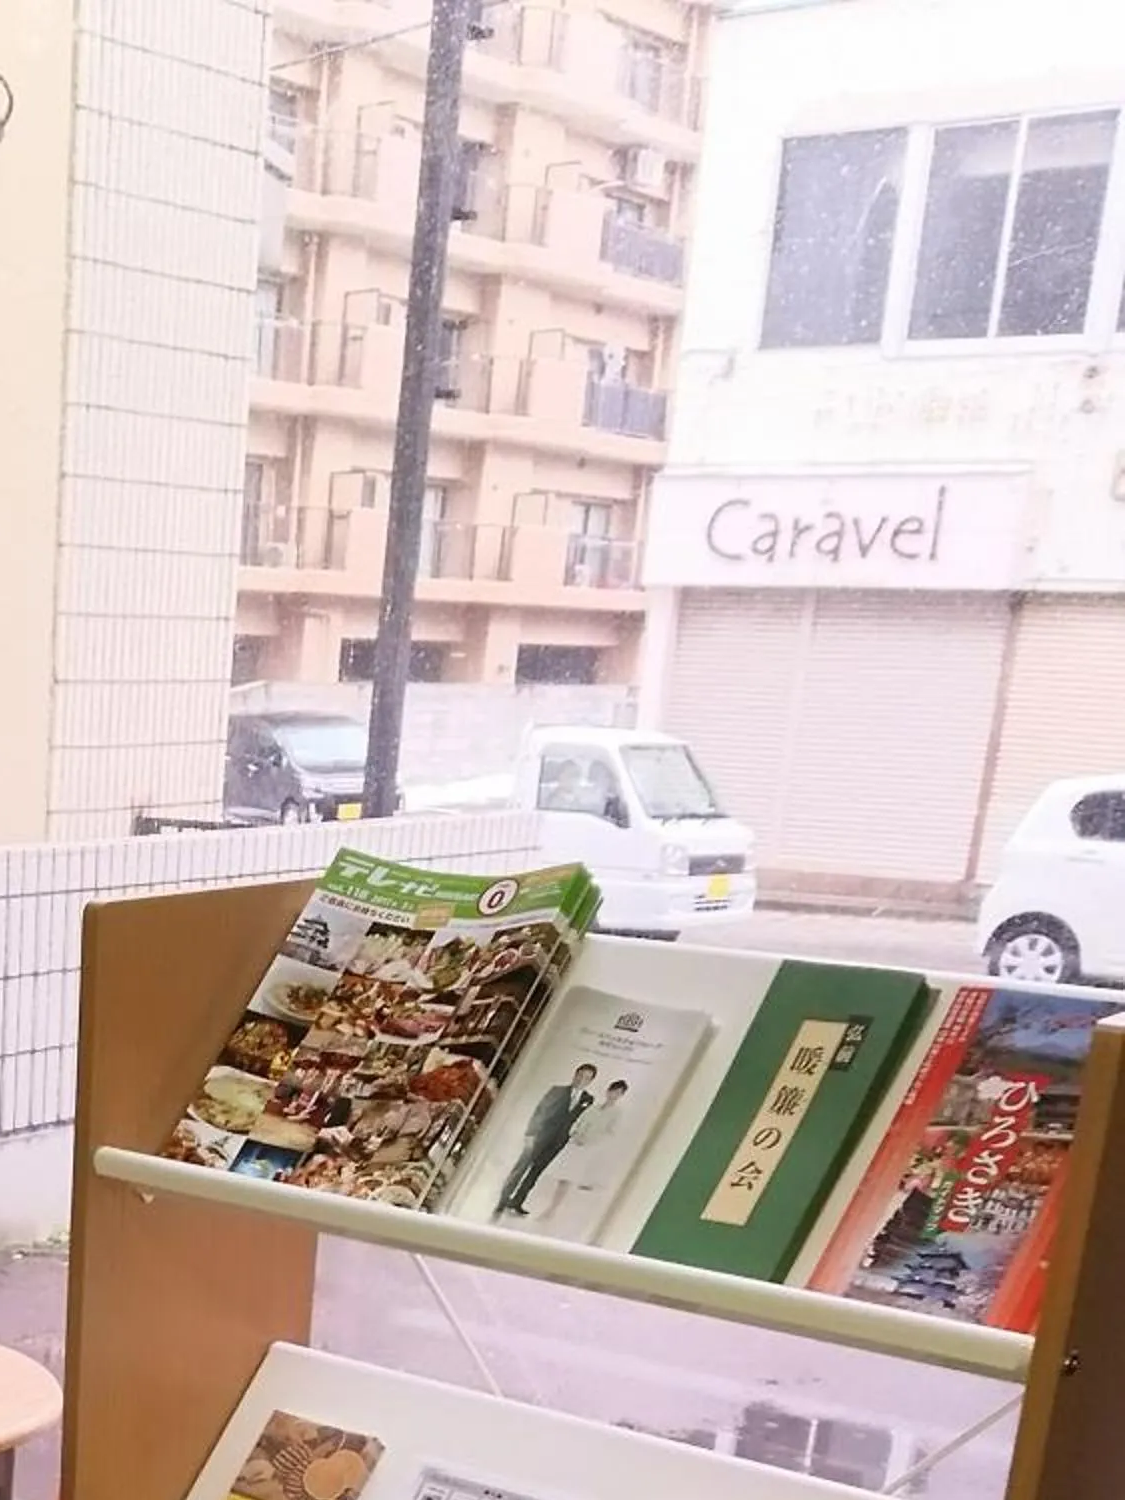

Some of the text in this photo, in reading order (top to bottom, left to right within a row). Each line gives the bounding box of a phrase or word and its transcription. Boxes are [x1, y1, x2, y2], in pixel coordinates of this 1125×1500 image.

[706, 484, 947, 563] Caravel
[487, 890, 506, 909] 0
[730, 1045, 826, 1192] 暖簾の会
[947, 1081, 1040, 1223] ひろさき
